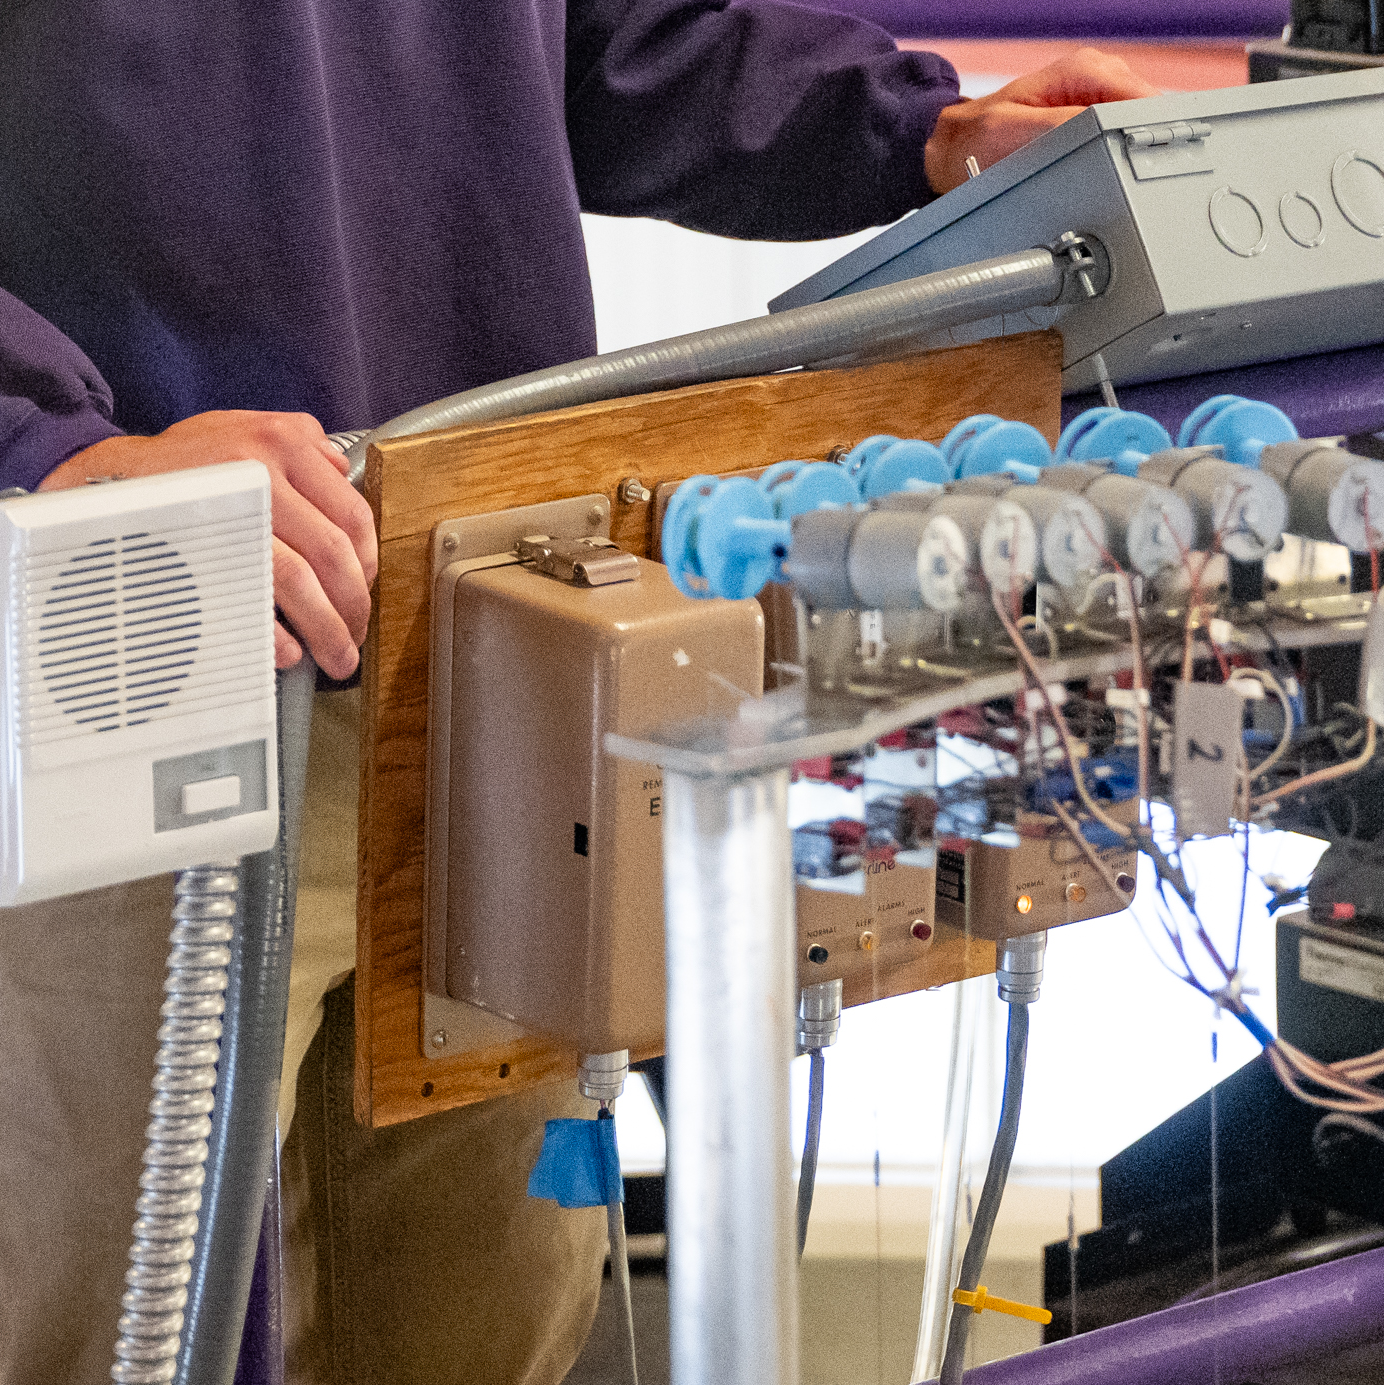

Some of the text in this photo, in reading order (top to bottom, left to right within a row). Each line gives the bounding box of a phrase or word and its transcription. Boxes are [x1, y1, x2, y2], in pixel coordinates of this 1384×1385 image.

[1061, 871, 1081, 881] AERT
[1016, 879, 1045, 891] NORMAL
[877, 900, 906, 912] ALARMS
